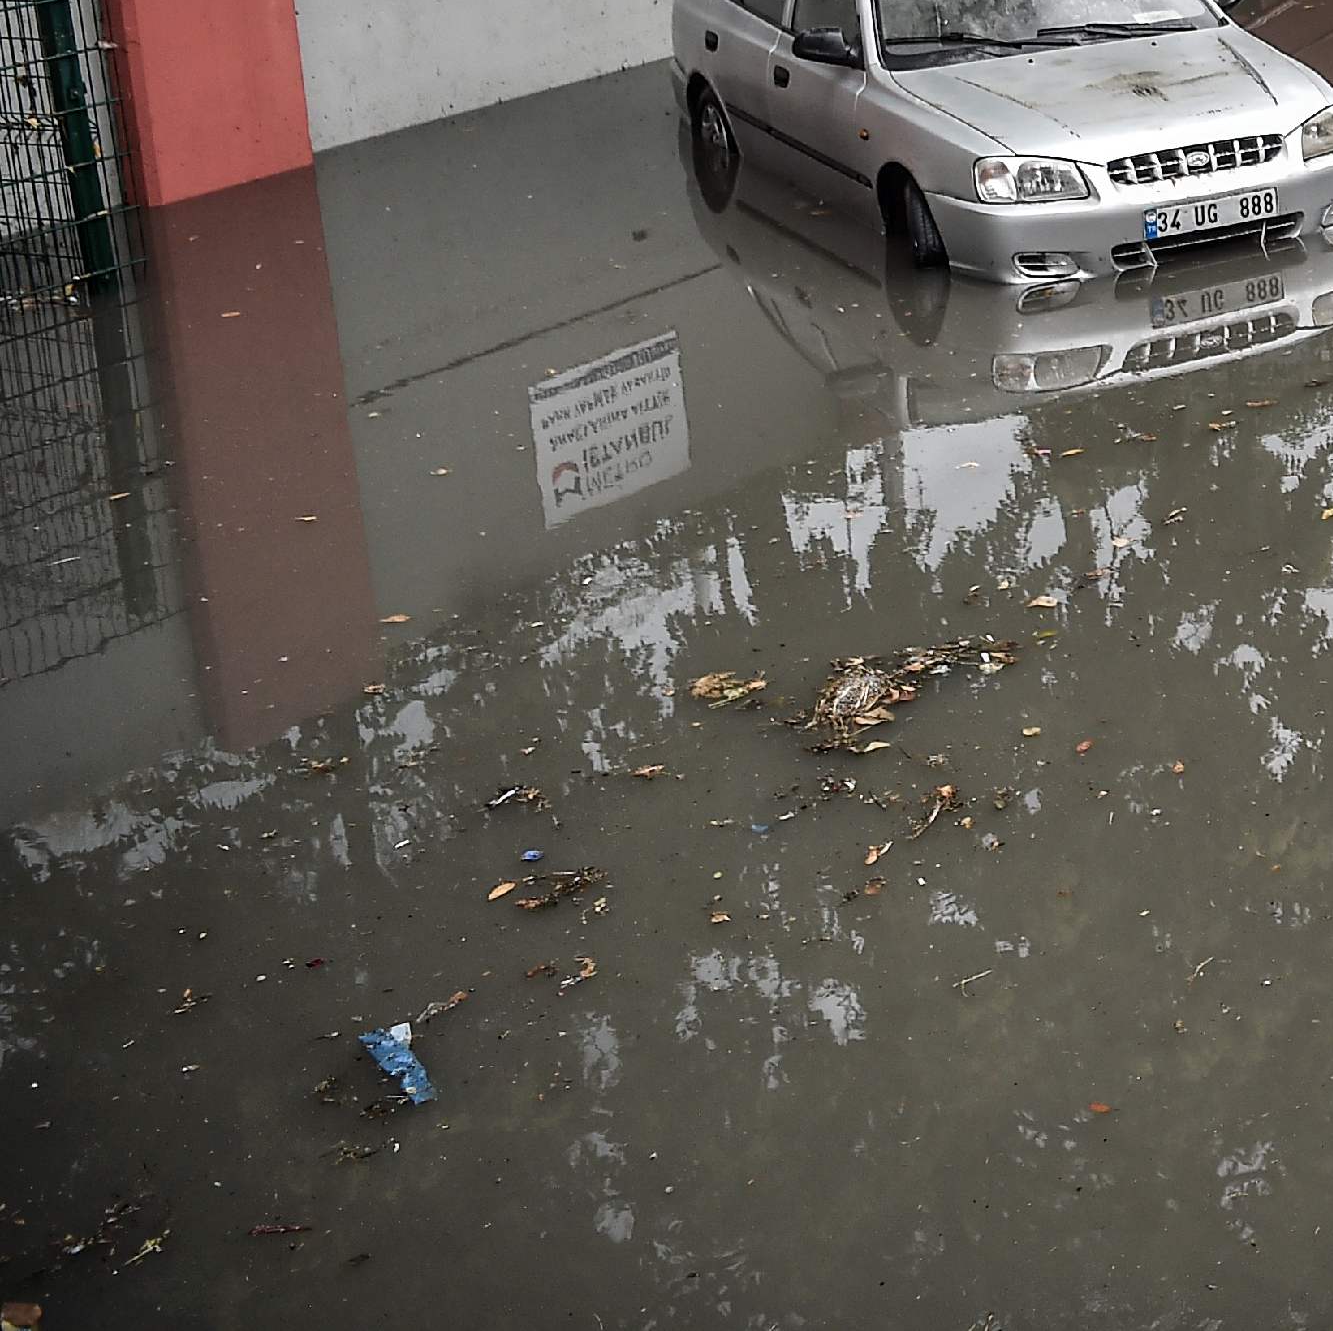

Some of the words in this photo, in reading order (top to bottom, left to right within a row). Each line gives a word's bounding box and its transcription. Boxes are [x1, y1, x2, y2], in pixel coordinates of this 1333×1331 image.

[1157, 209, 1182, 232] 34
[1194, 203, 1218, 226] UG
[1239, 192, 1274, 218] 888
